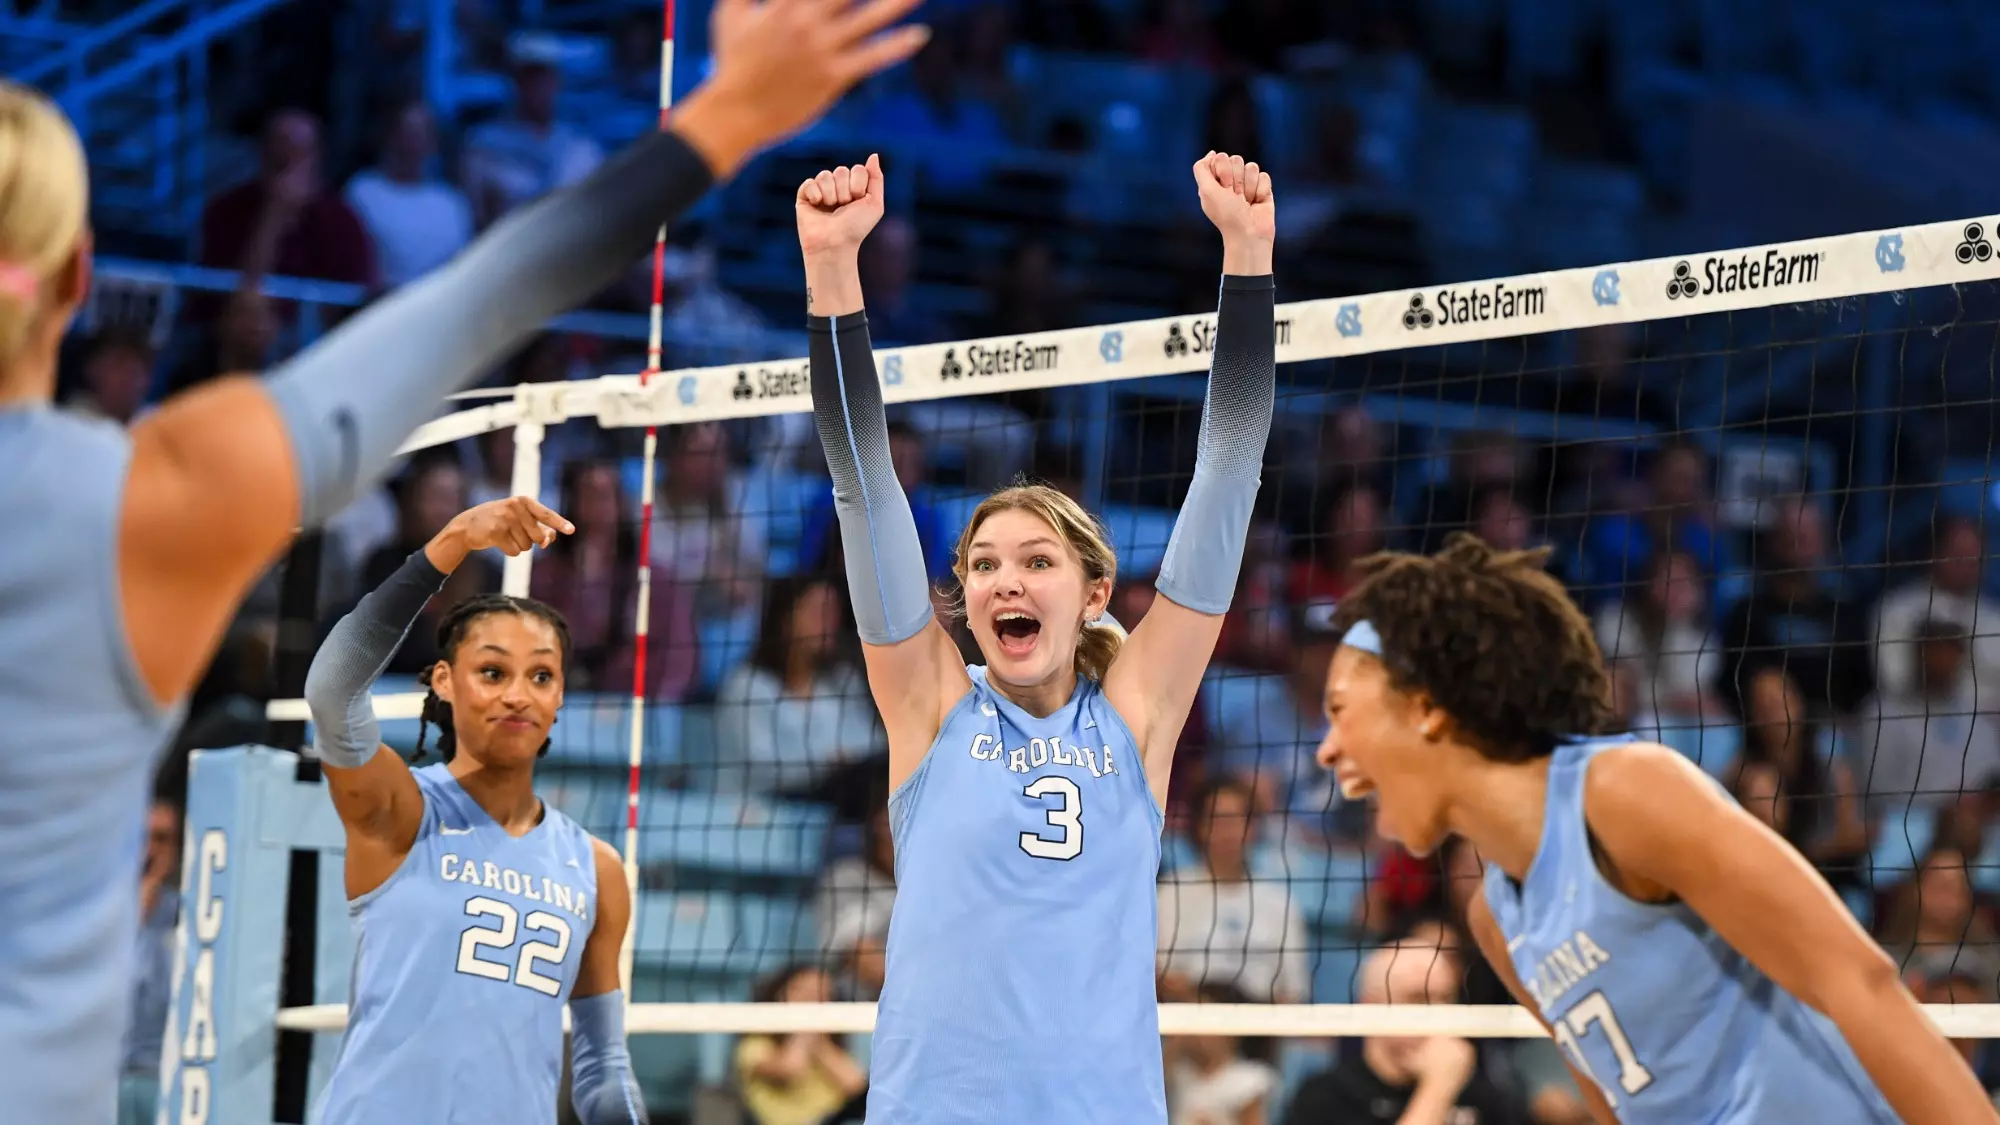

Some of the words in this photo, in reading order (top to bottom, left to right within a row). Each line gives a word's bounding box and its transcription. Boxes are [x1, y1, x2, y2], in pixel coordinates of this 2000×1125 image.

[1018, 775, 1084, 861] 3
[440, 853, 588, 921] CAROLINA
[455, 895, 572, 998] 22
